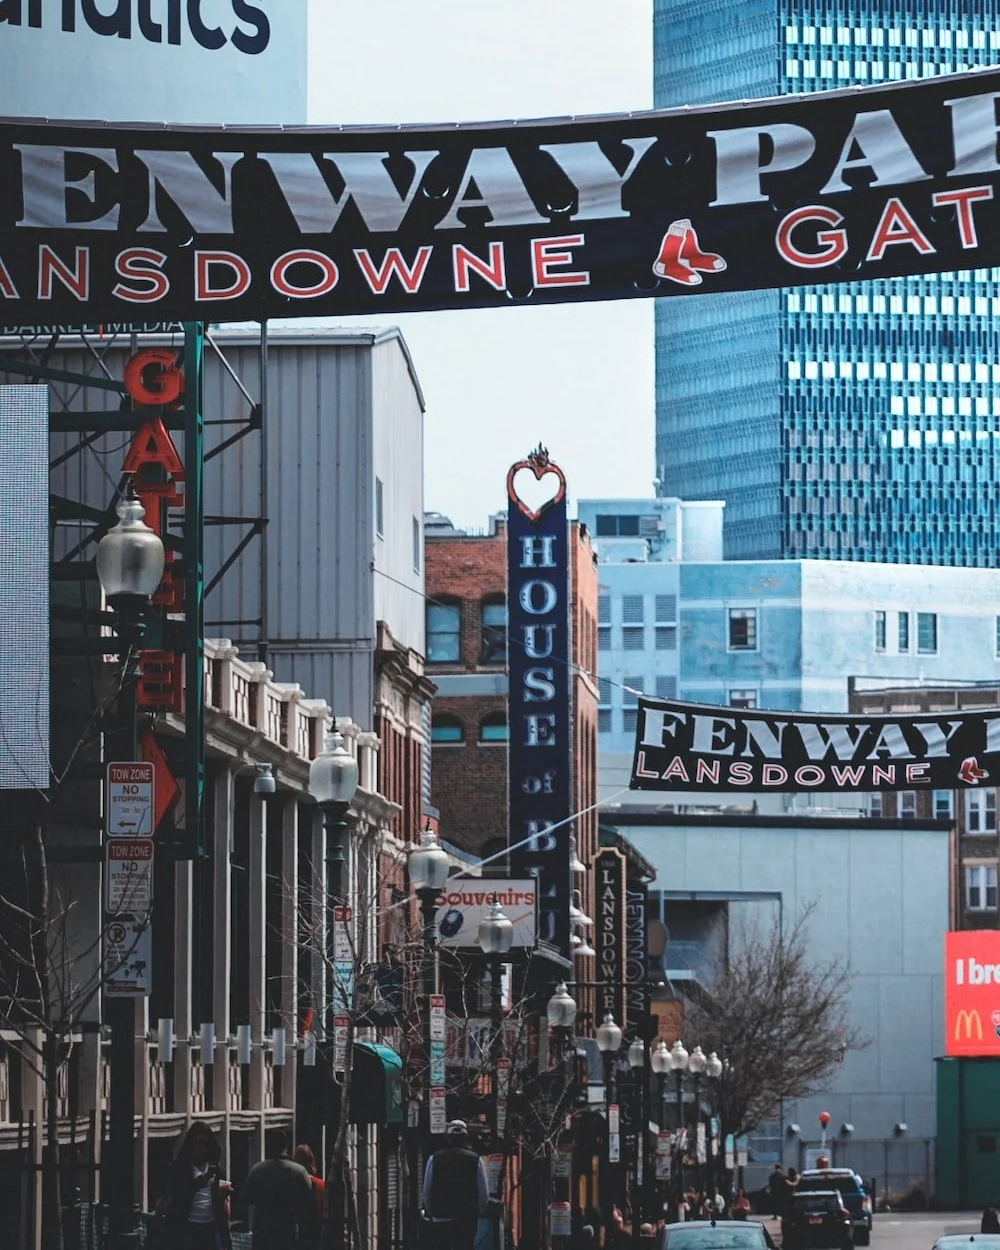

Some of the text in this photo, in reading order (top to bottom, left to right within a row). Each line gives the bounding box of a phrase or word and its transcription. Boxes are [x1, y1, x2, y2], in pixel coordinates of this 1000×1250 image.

[12, 137, 659, 235] ENWAY
[518, 534, 559, 747] HOUSE
[640, 706, 963, 761] FENWAY
[111, 768, 151, 780] TOW ZONE
[520, 768, 558, 795] of
[635, 751, 931, 786] LANSDOWNE
[121, 785, 139, 795] NO
[111, 845, 151, 857] TOW ZONE
[121, 862, 139, 872] NO
[434, 887, 535, 907] Souvenirs
[600, 869, 617, 1010] LANSDOWNE
[956, 958, 964, 985] I
